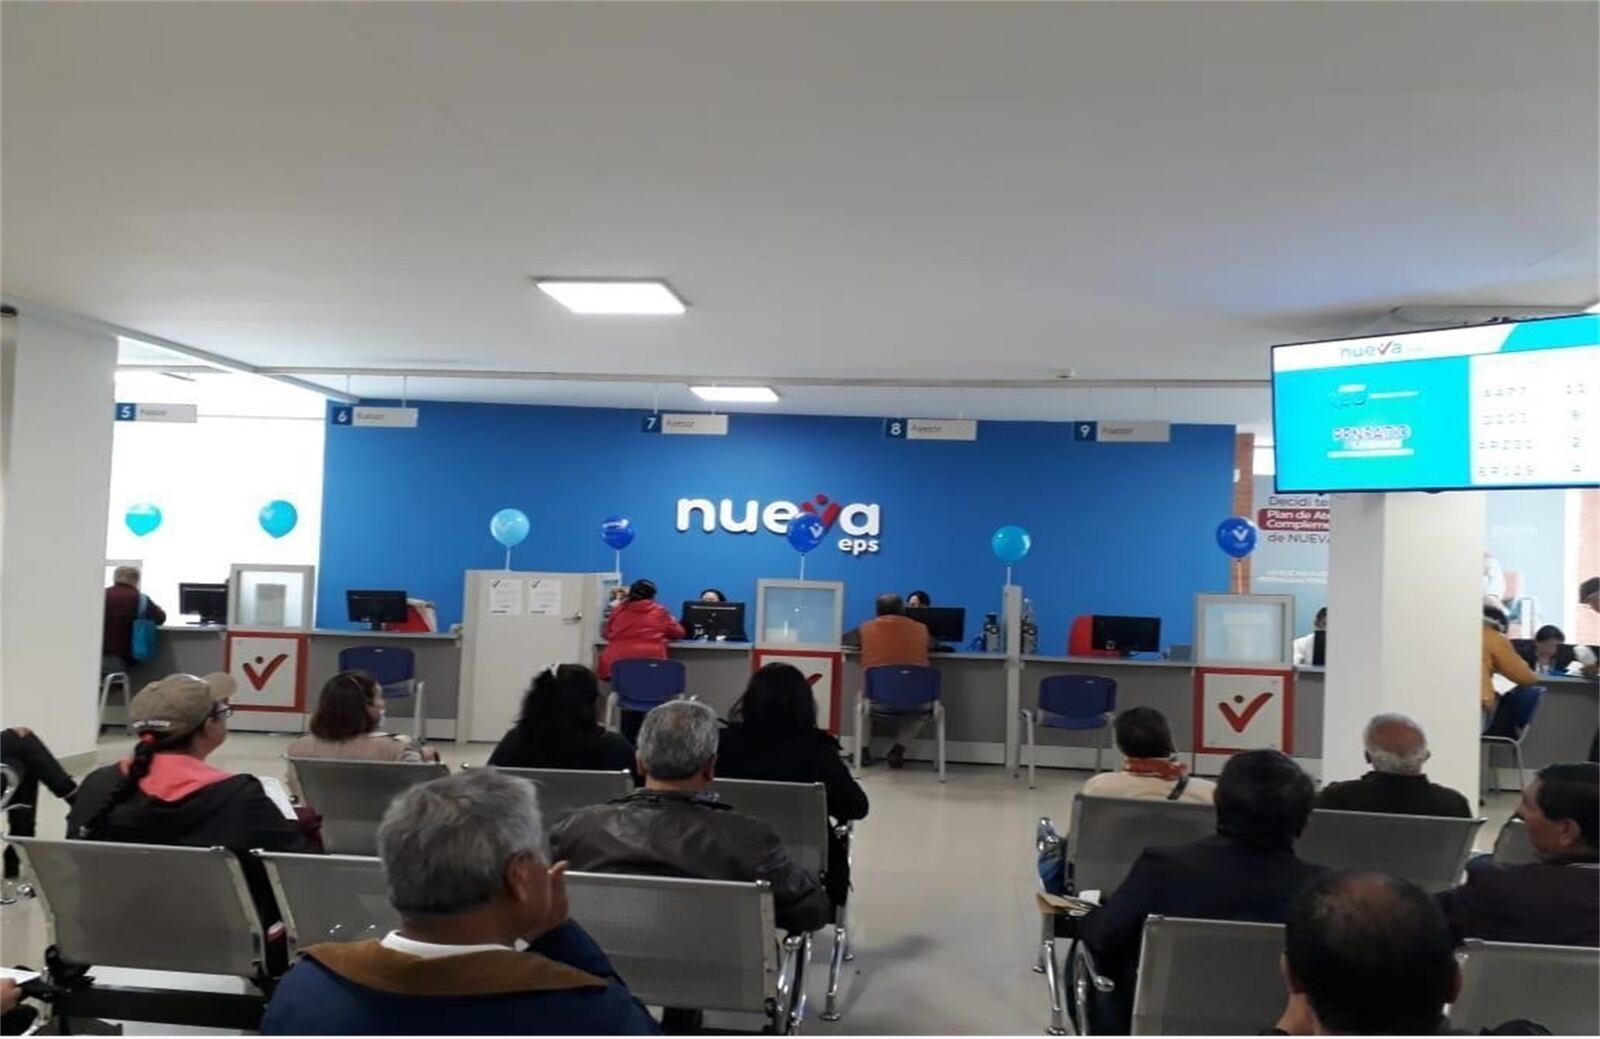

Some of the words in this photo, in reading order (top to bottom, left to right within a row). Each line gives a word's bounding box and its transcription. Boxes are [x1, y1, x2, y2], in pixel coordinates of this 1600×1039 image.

[120, 405, 132, 418] 5
[337, 410, 348, 423] 6
[646, 416, 657, 429] 7
[889, 422, 902, 436] 8
[1080, 424, 1091, 438] 9
[1266, 510, 1294, 519] Plan
[1296, 510, 1311, 519] de
[837, 538, 880, 555] eps
